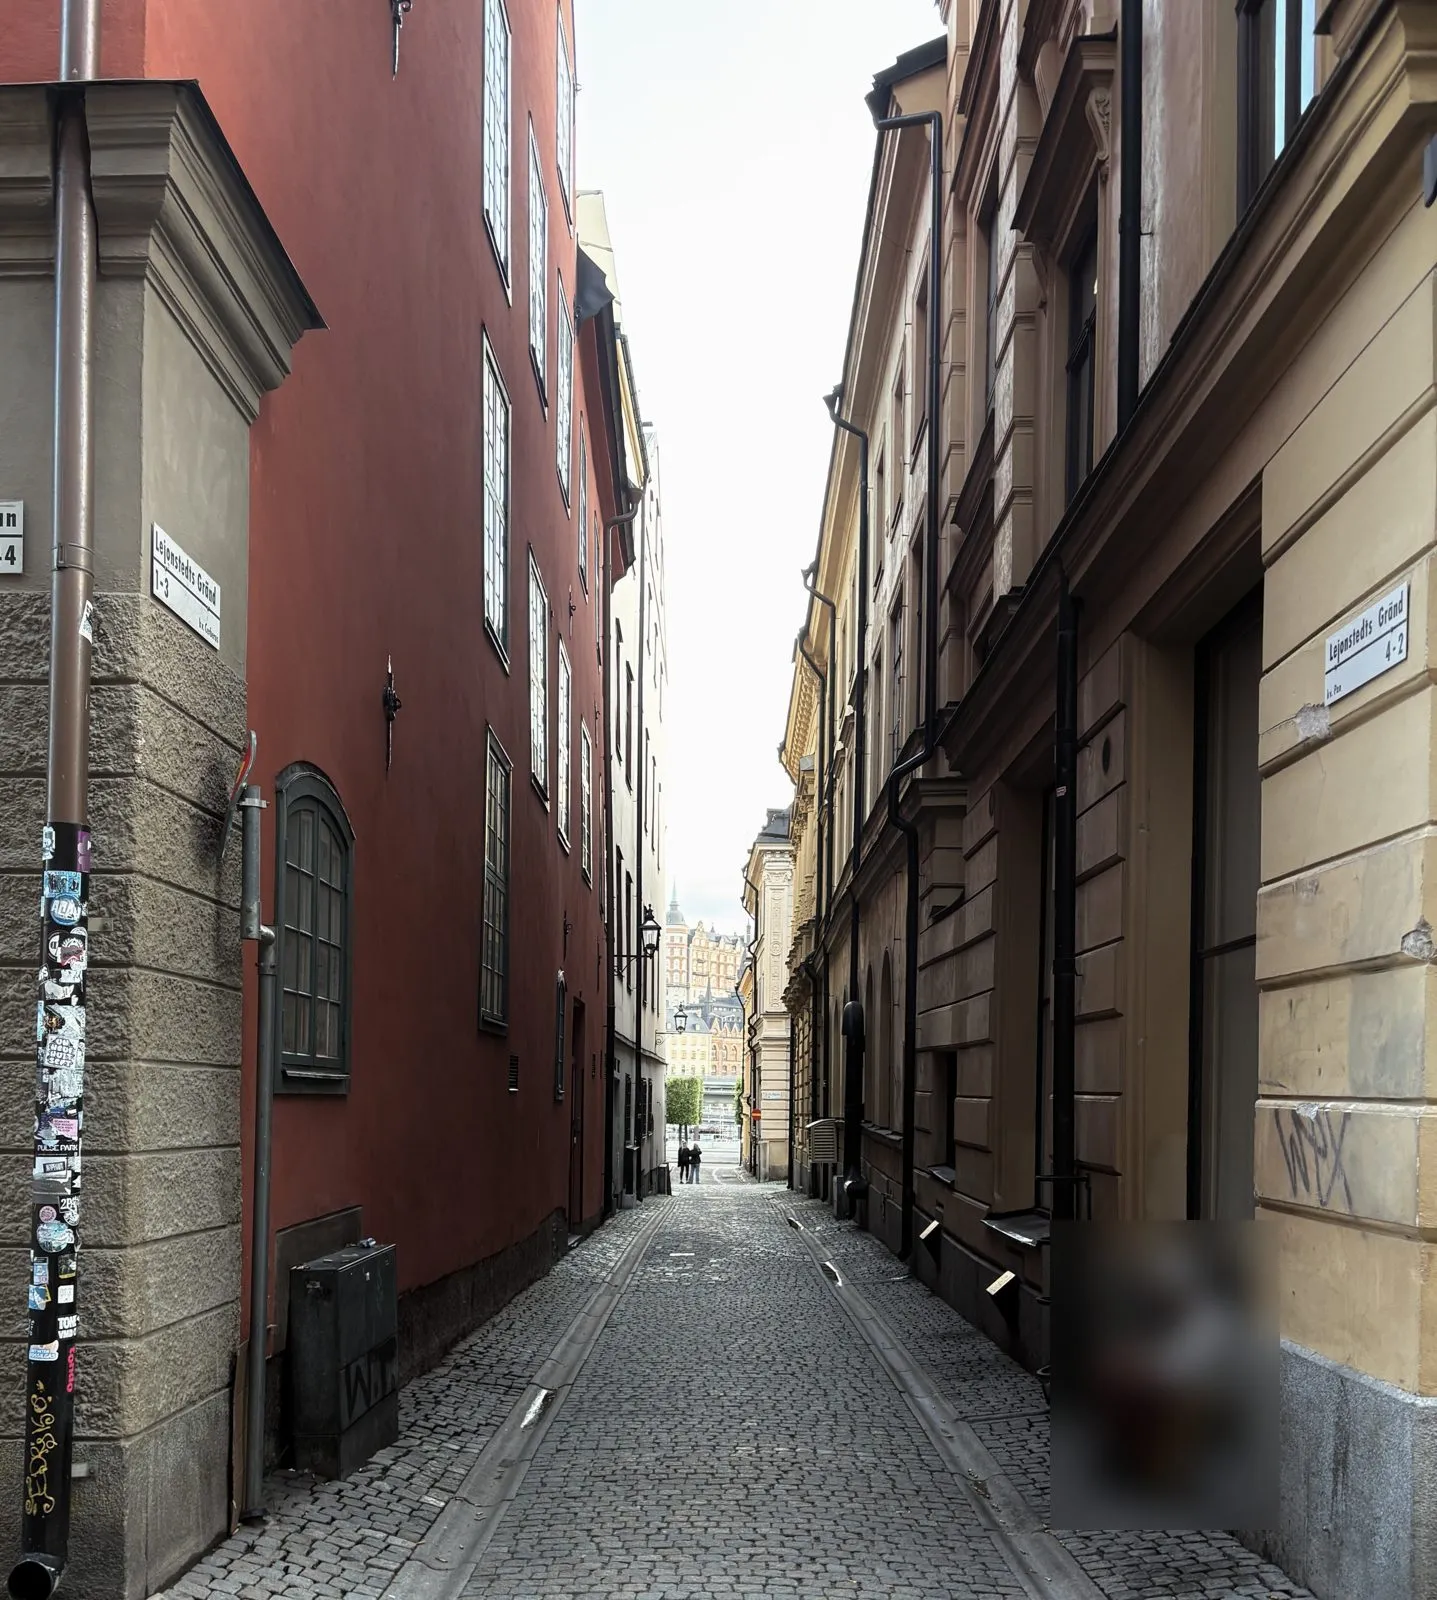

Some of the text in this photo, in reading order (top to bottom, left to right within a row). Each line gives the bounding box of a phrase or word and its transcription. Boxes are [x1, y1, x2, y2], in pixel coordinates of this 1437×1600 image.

[155, 530, 217, 606] Lejonstedts Gränd
[1329, 590, 1404, 663] Lejonstedts Gränd
